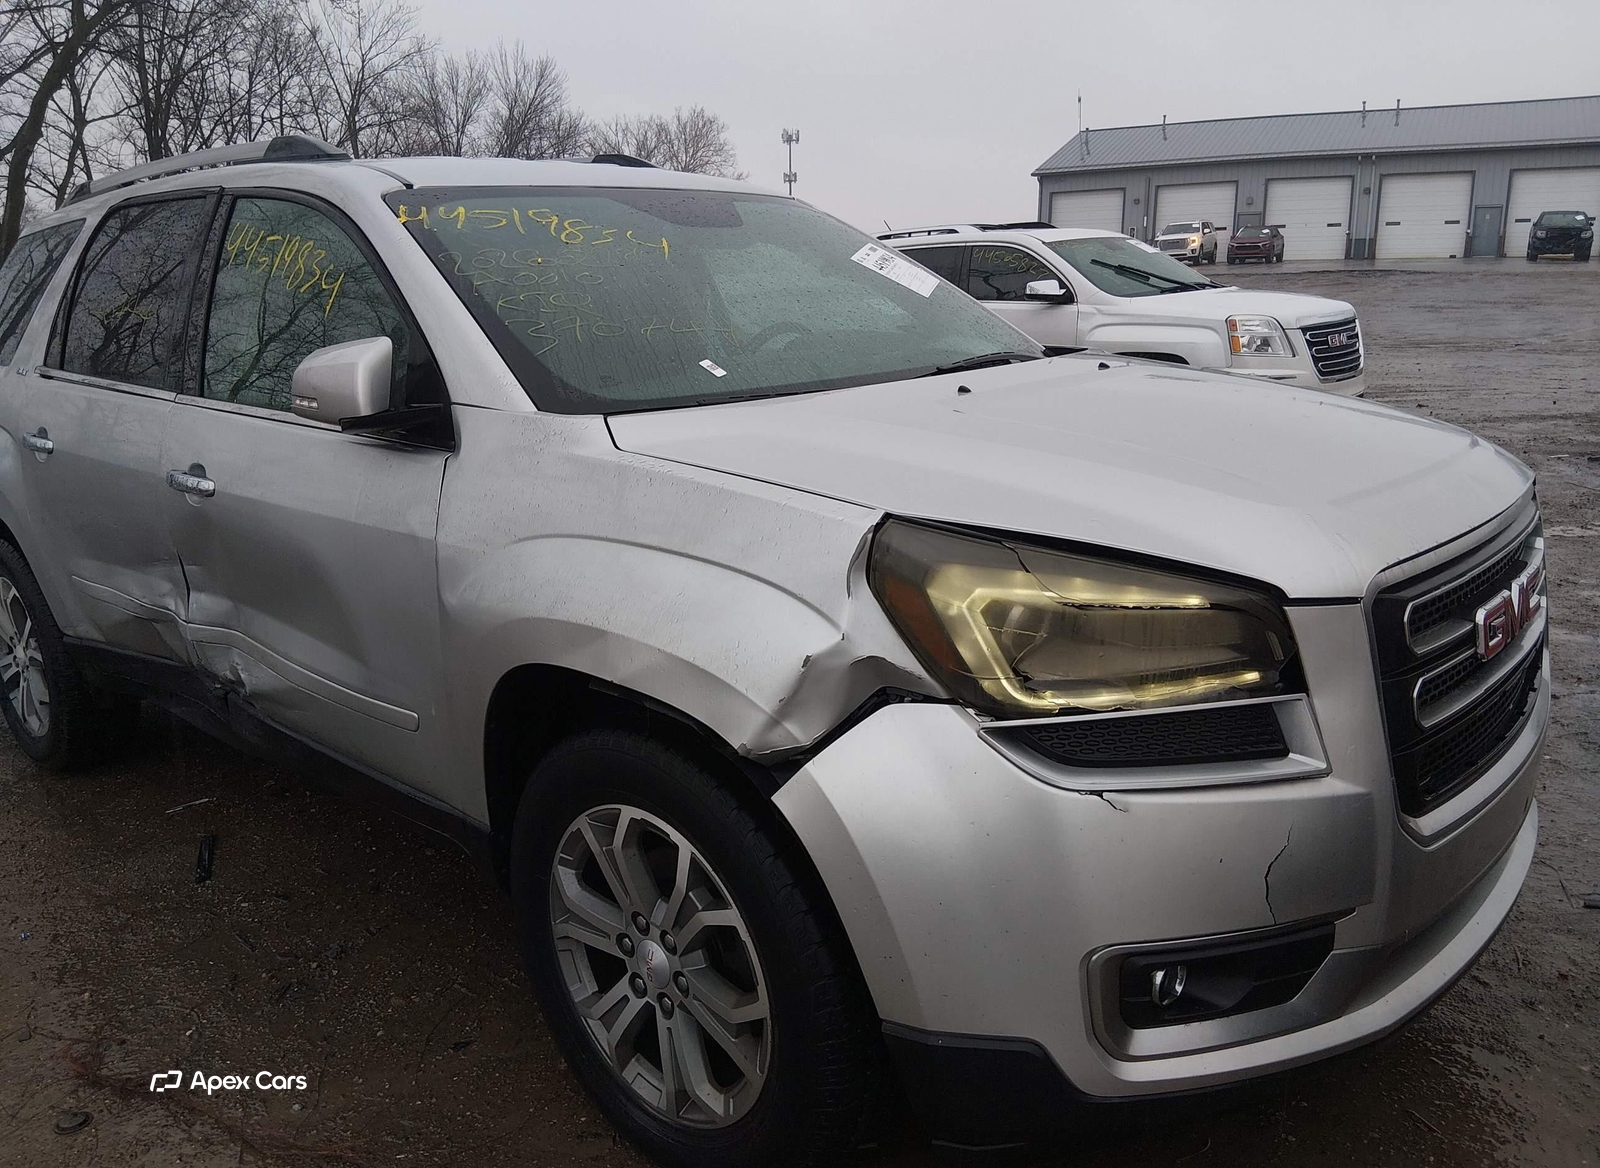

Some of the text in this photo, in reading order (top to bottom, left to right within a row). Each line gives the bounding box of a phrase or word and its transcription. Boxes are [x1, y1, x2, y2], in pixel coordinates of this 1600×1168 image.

[227, 222, 345, 318] 44519834
[1327, 332, 1352, 347] GMC
[1476, 564, 1542, 662] GMC
[646, 946, 655, 982] GMC
